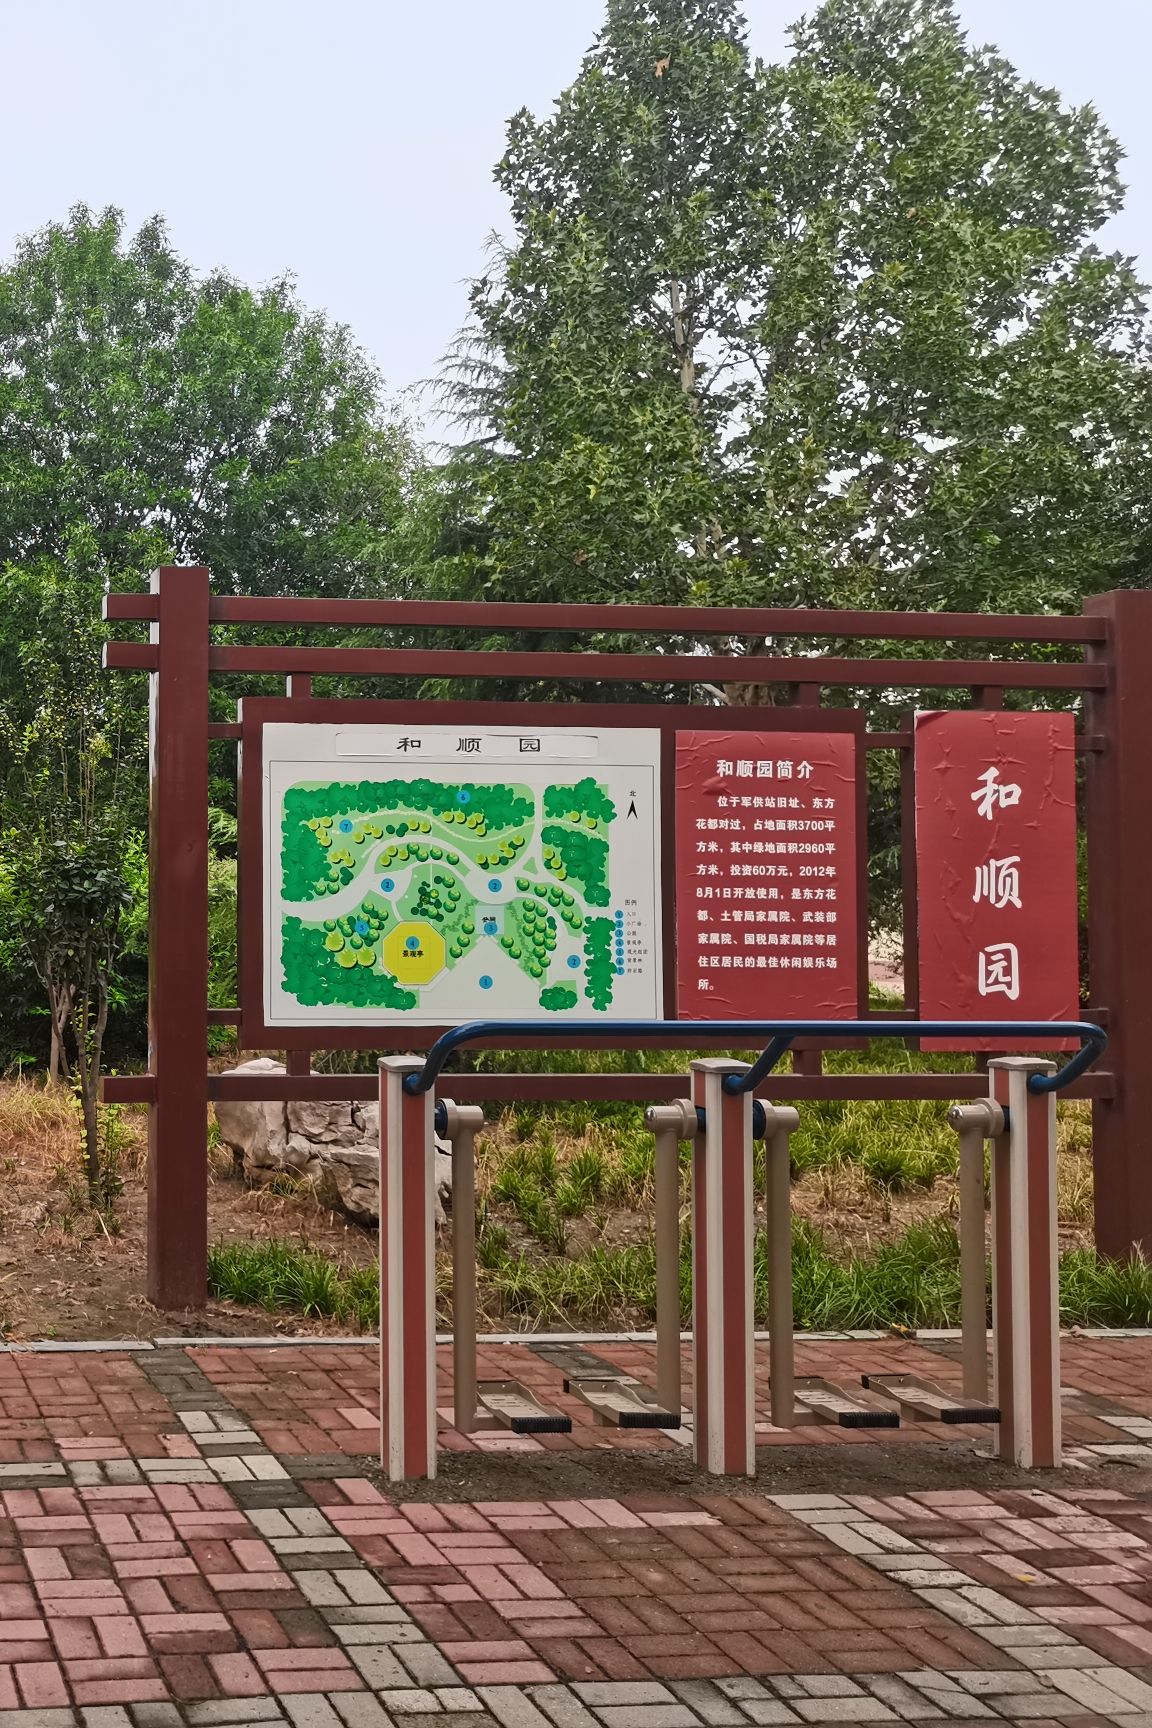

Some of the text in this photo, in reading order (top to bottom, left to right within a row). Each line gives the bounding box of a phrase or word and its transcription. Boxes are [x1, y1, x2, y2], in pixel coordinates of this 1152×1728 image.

[396, 736, 541, 753] 和顺园
[716, 759, 814, 779] 和顺园简介
[717, 796, 836, 809] 位于军供站旧址、东方
[970, 765, 1023, 1001] 和顺园
[697, 933, 837, 947] 家属院、国税局家属院等居
[697, 956, 838, 970] 住区居民的最佳休闲娱乐场
